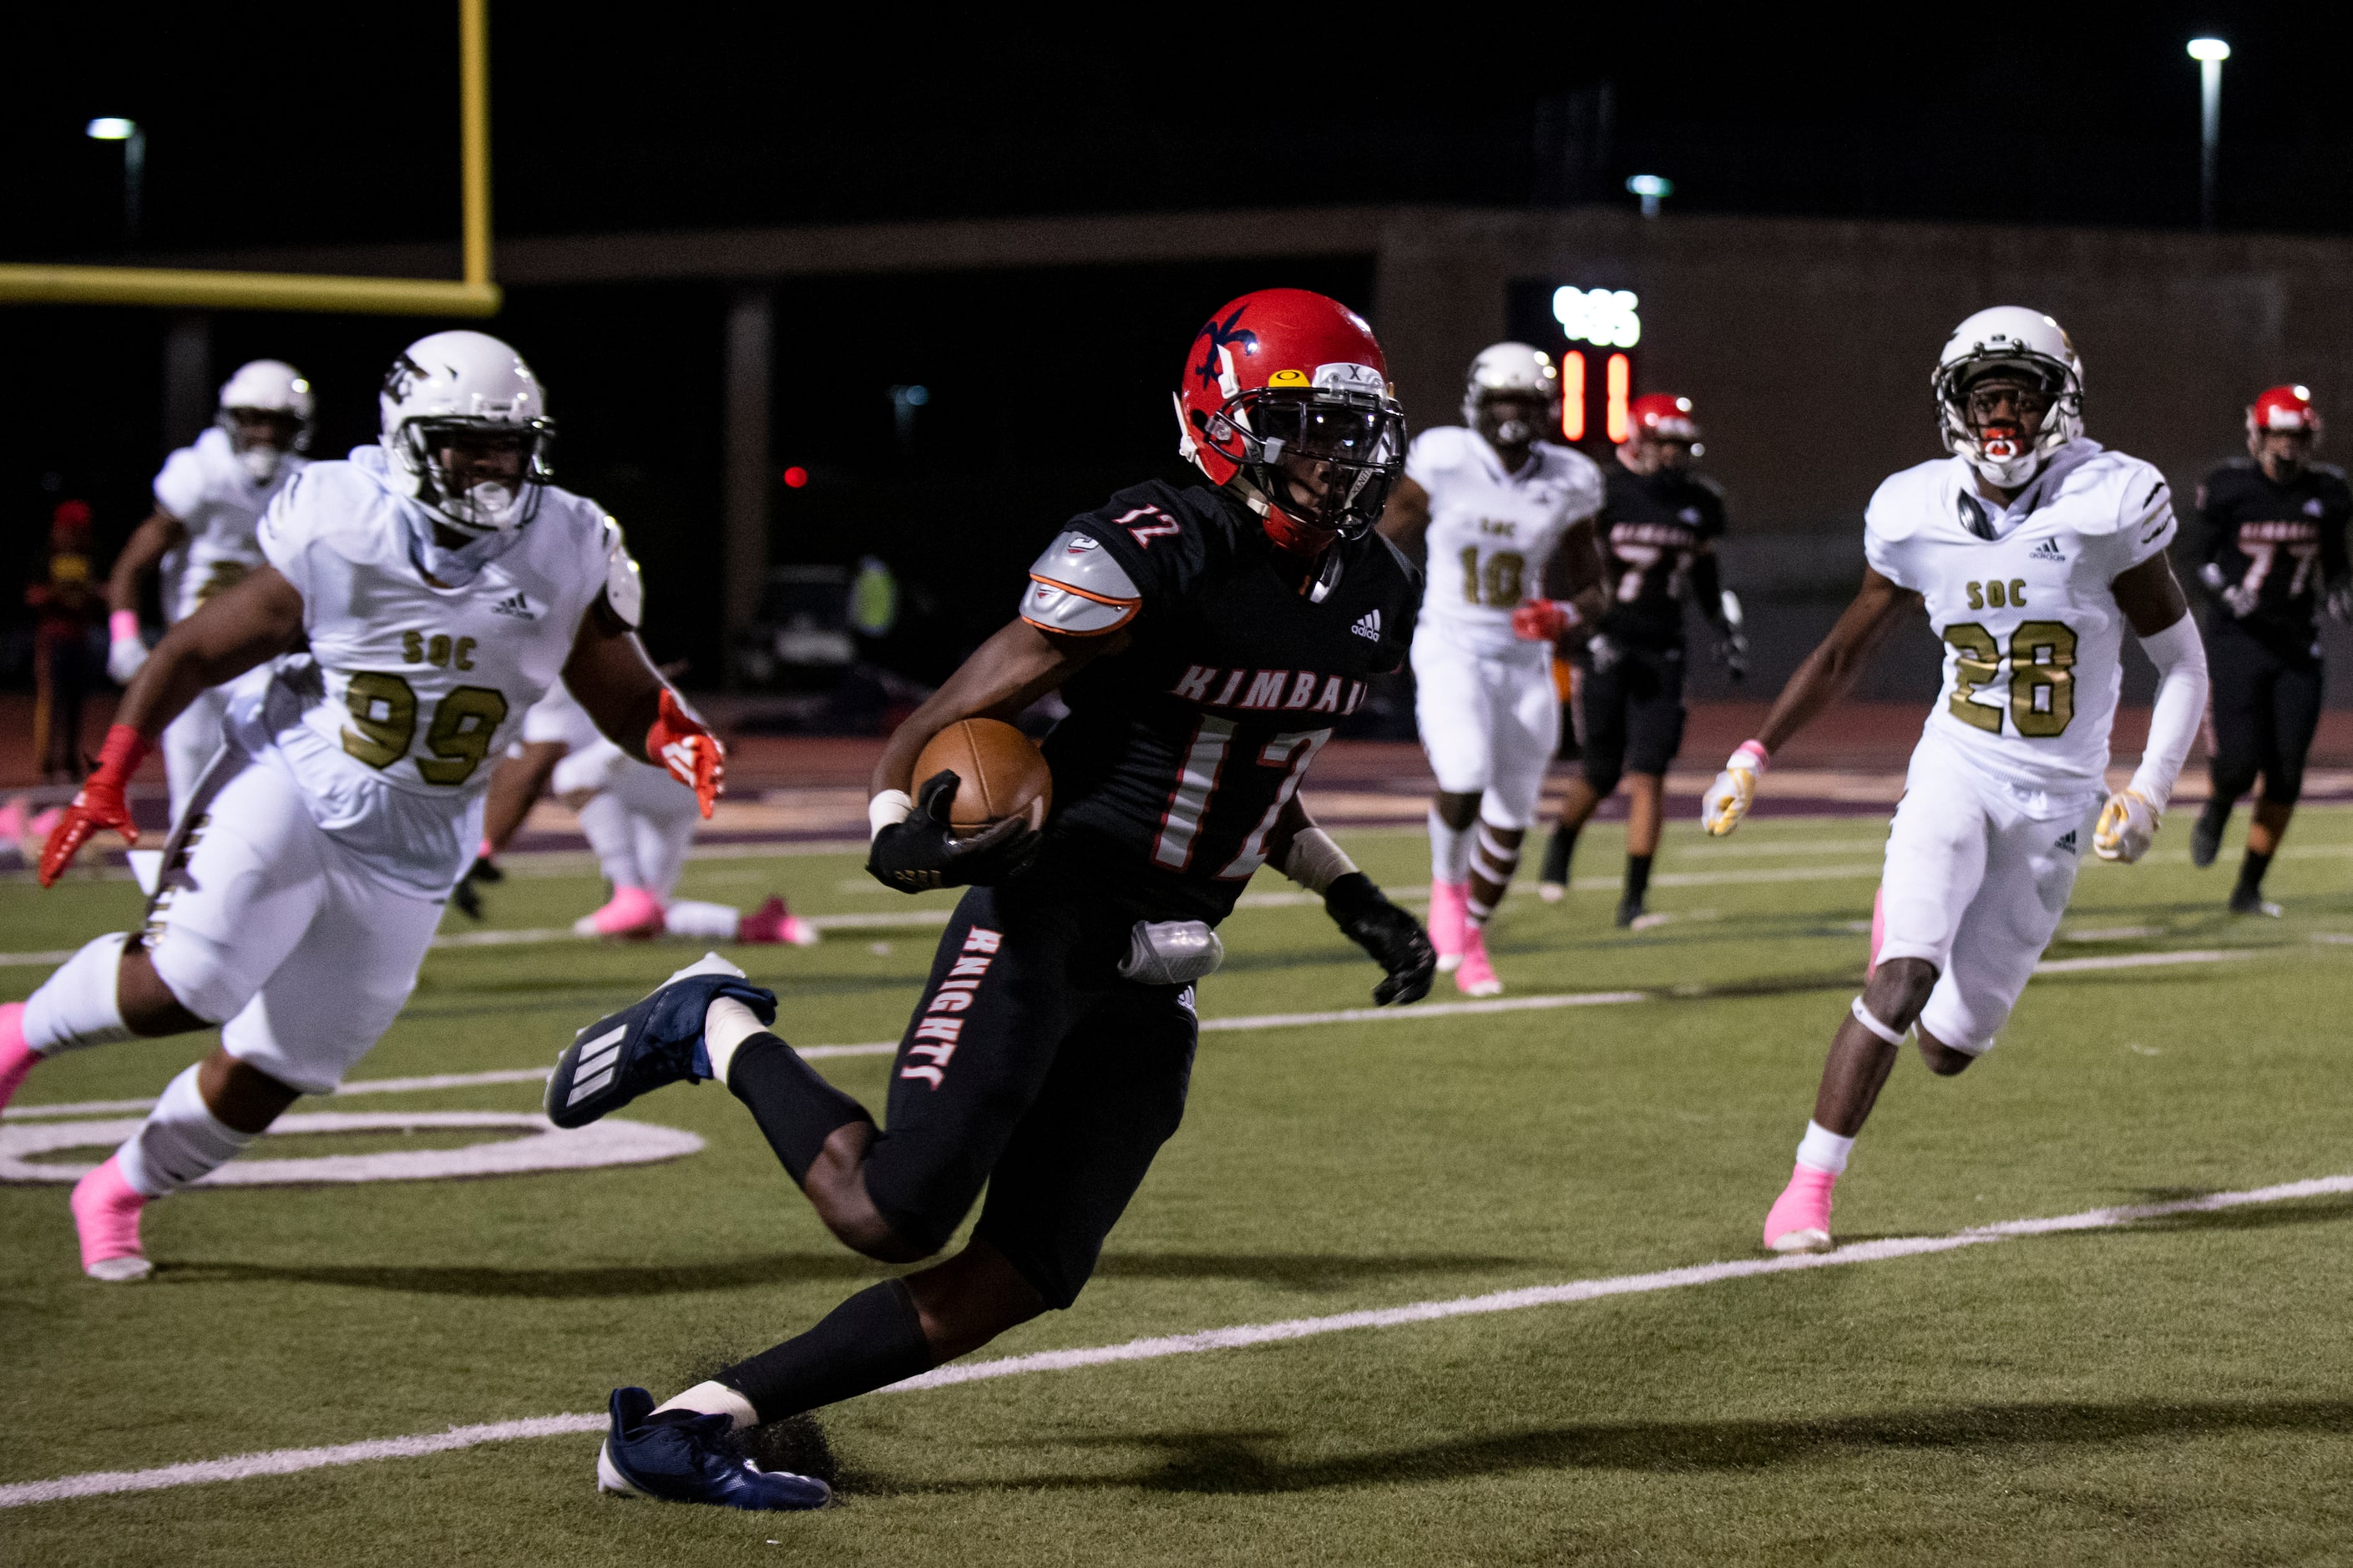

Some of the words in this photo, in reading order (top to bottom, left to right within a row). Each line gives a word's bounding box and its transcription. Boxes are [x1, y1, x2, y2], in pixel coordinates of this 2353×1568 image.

[1351, 468, 1370, 495] XENIT
[1111, 503, 1182, 549] 12
[1460, 547, 1525, 609] 10
[1966, 579, 2027, 610] SOC
[402, 630, 478, 671] SOC
[1351, 625, 1380, 643] adida
[1169, 665, 1368, 715] KIMBAL
[1942, 620, 2077, 738] 28
[339, 670, 509, 787] 99
[1151, 713, 1335, 880] 12
